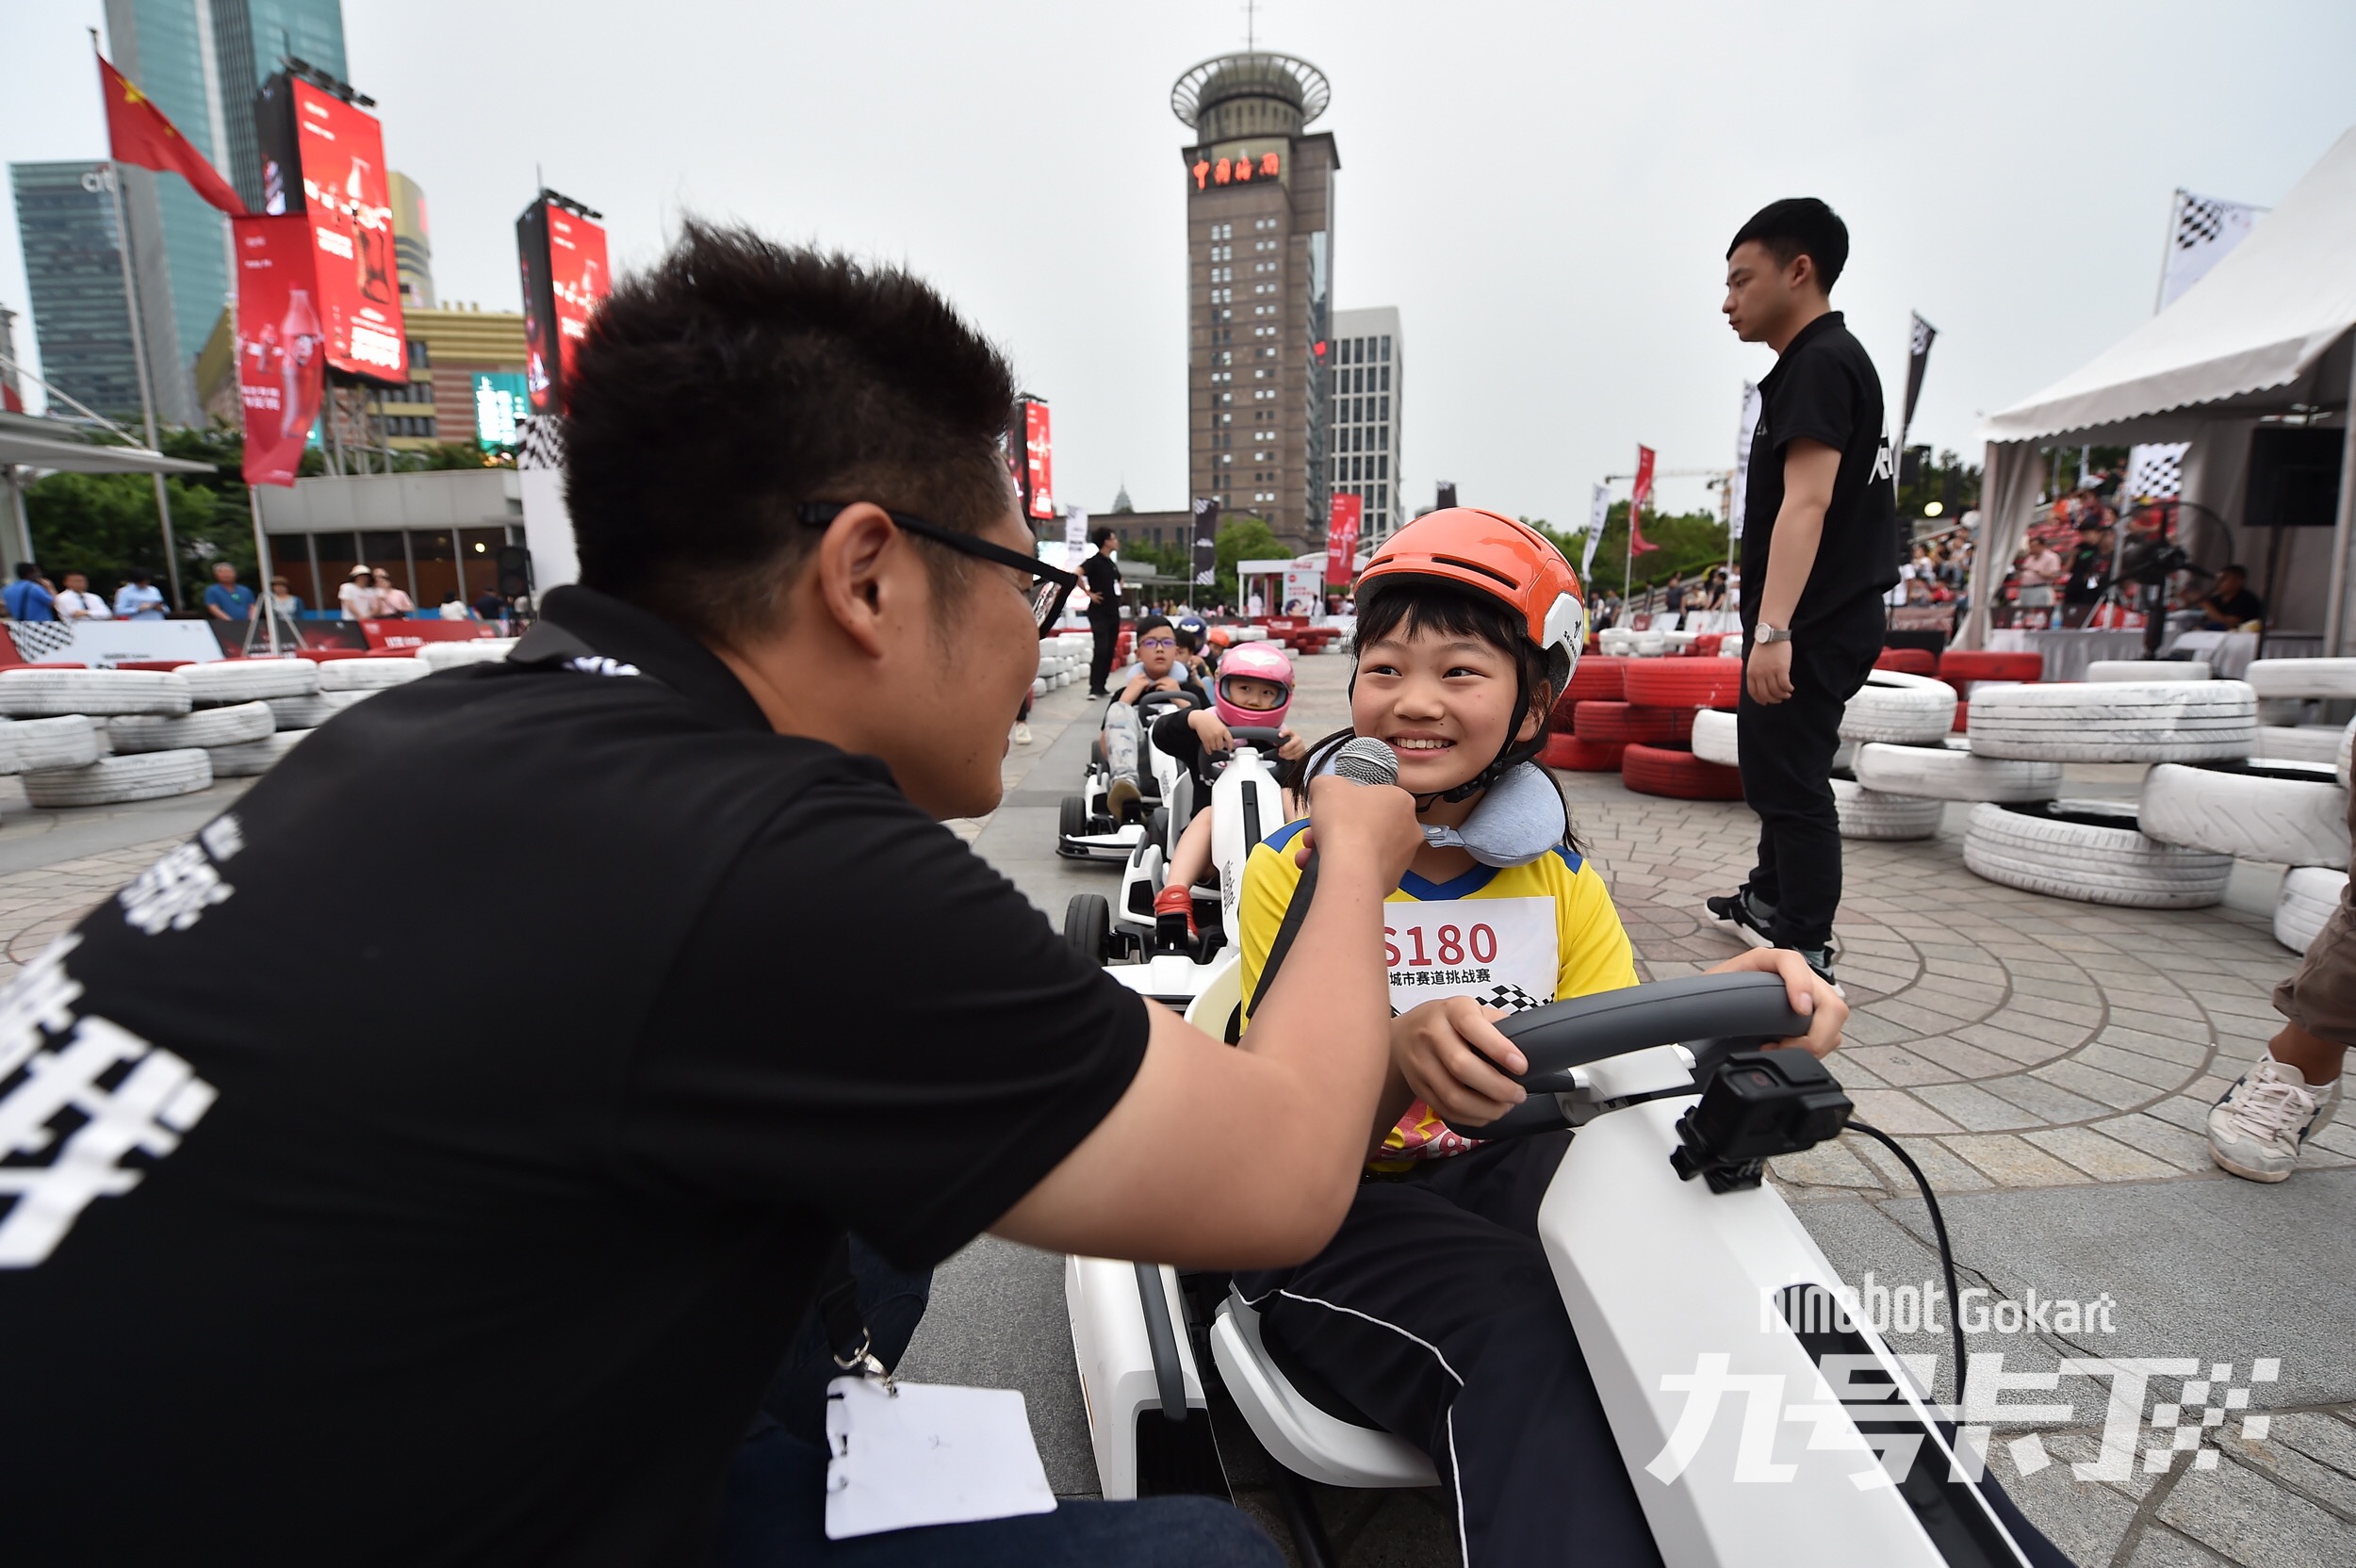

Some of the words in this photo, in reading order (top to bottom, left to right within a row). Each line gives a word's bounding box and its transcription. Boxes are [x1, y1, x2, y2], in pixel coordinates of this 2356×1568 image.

[81, 172, 116, 194] cit
[1389, 968, 1492, 987] 城市赛道挑战赛
